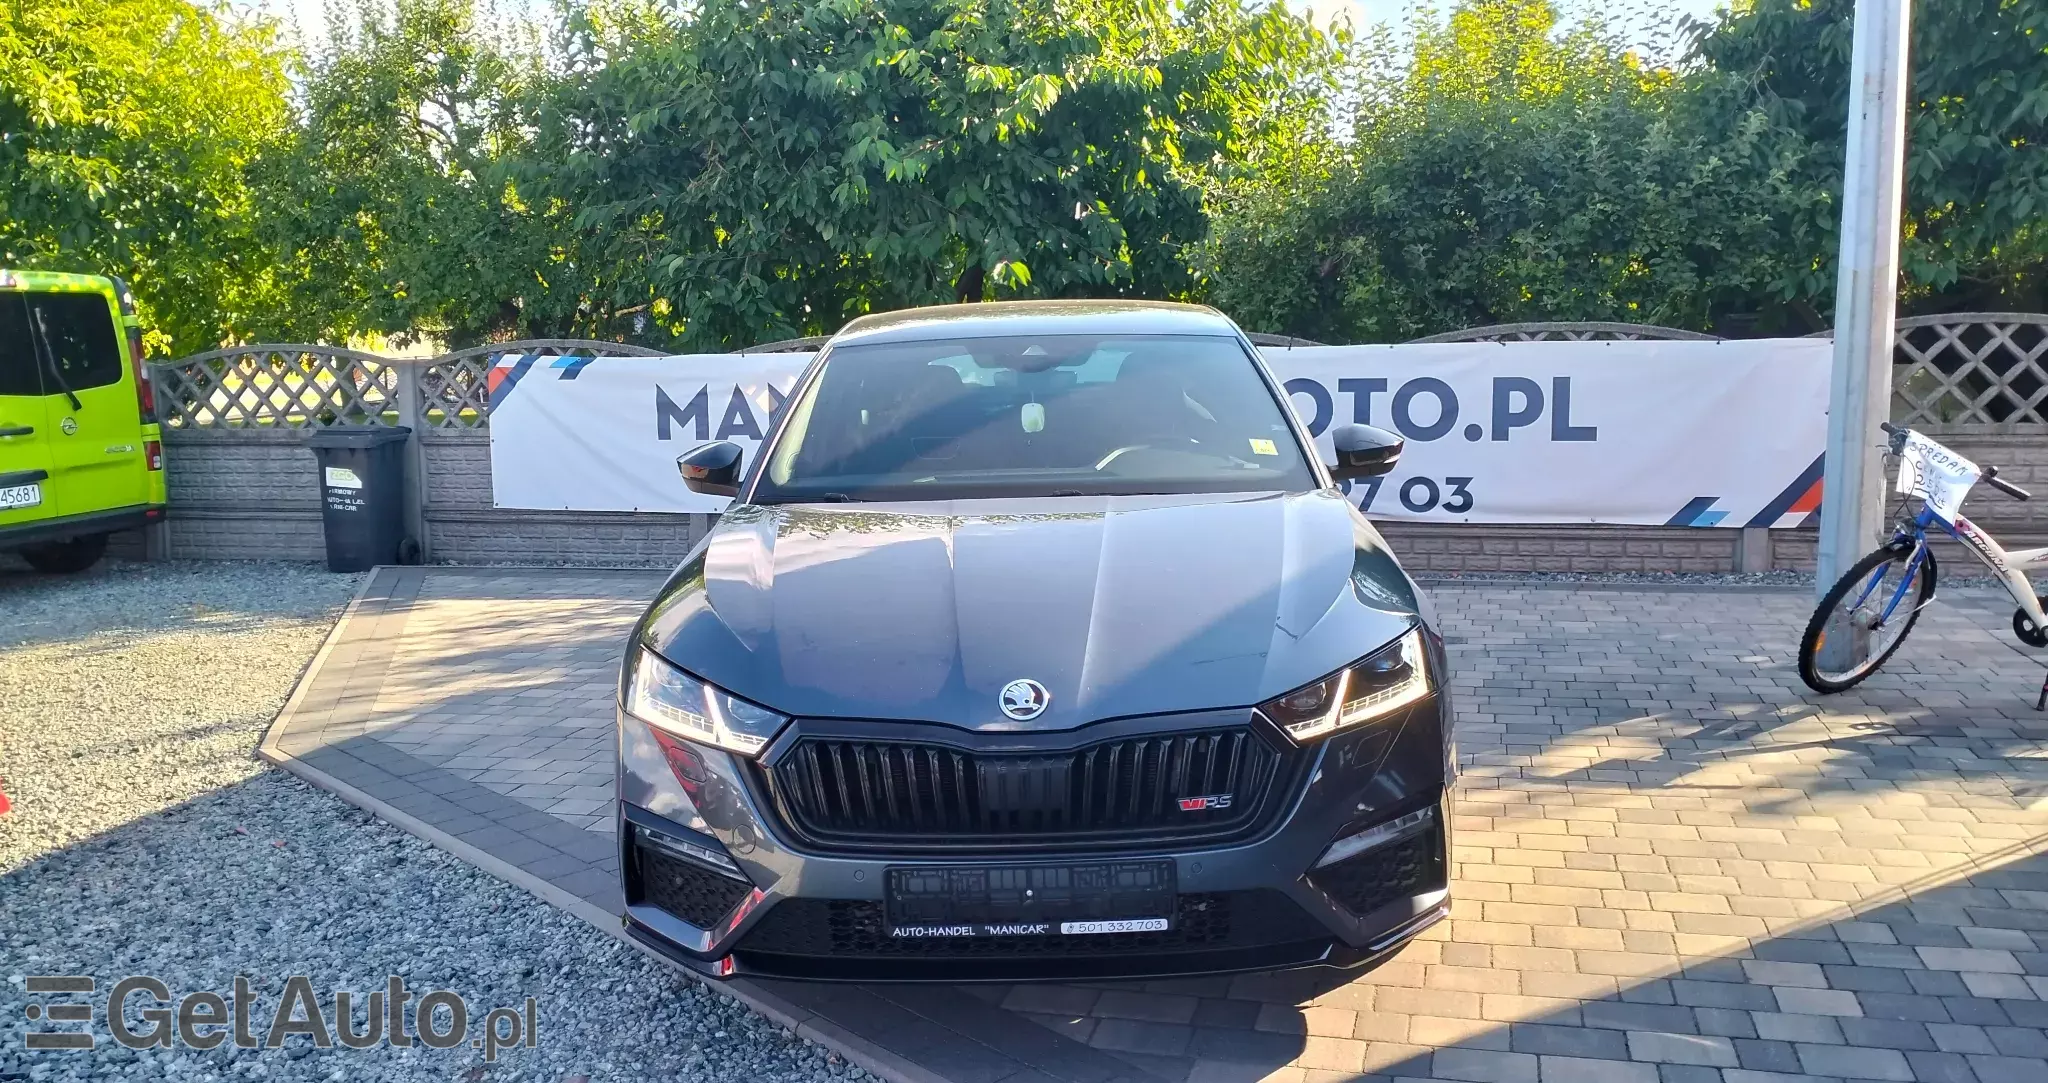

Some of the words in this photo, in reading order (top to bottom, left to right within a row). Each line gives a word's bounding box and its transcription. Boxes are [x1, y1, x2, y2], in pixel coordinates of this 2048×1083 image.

[0, 486, 37, 504] 45681
[1400, 476, 1474, 513] 03
[893, 926, 976, 937] AUTO-HANDEL
[984, 924, 1050, 935] "MANICAR"
[1078, 923, 1103, 933] 501
[1107, 921, 1133, 932] 332
[1137, 920, 1163, 930] 703
